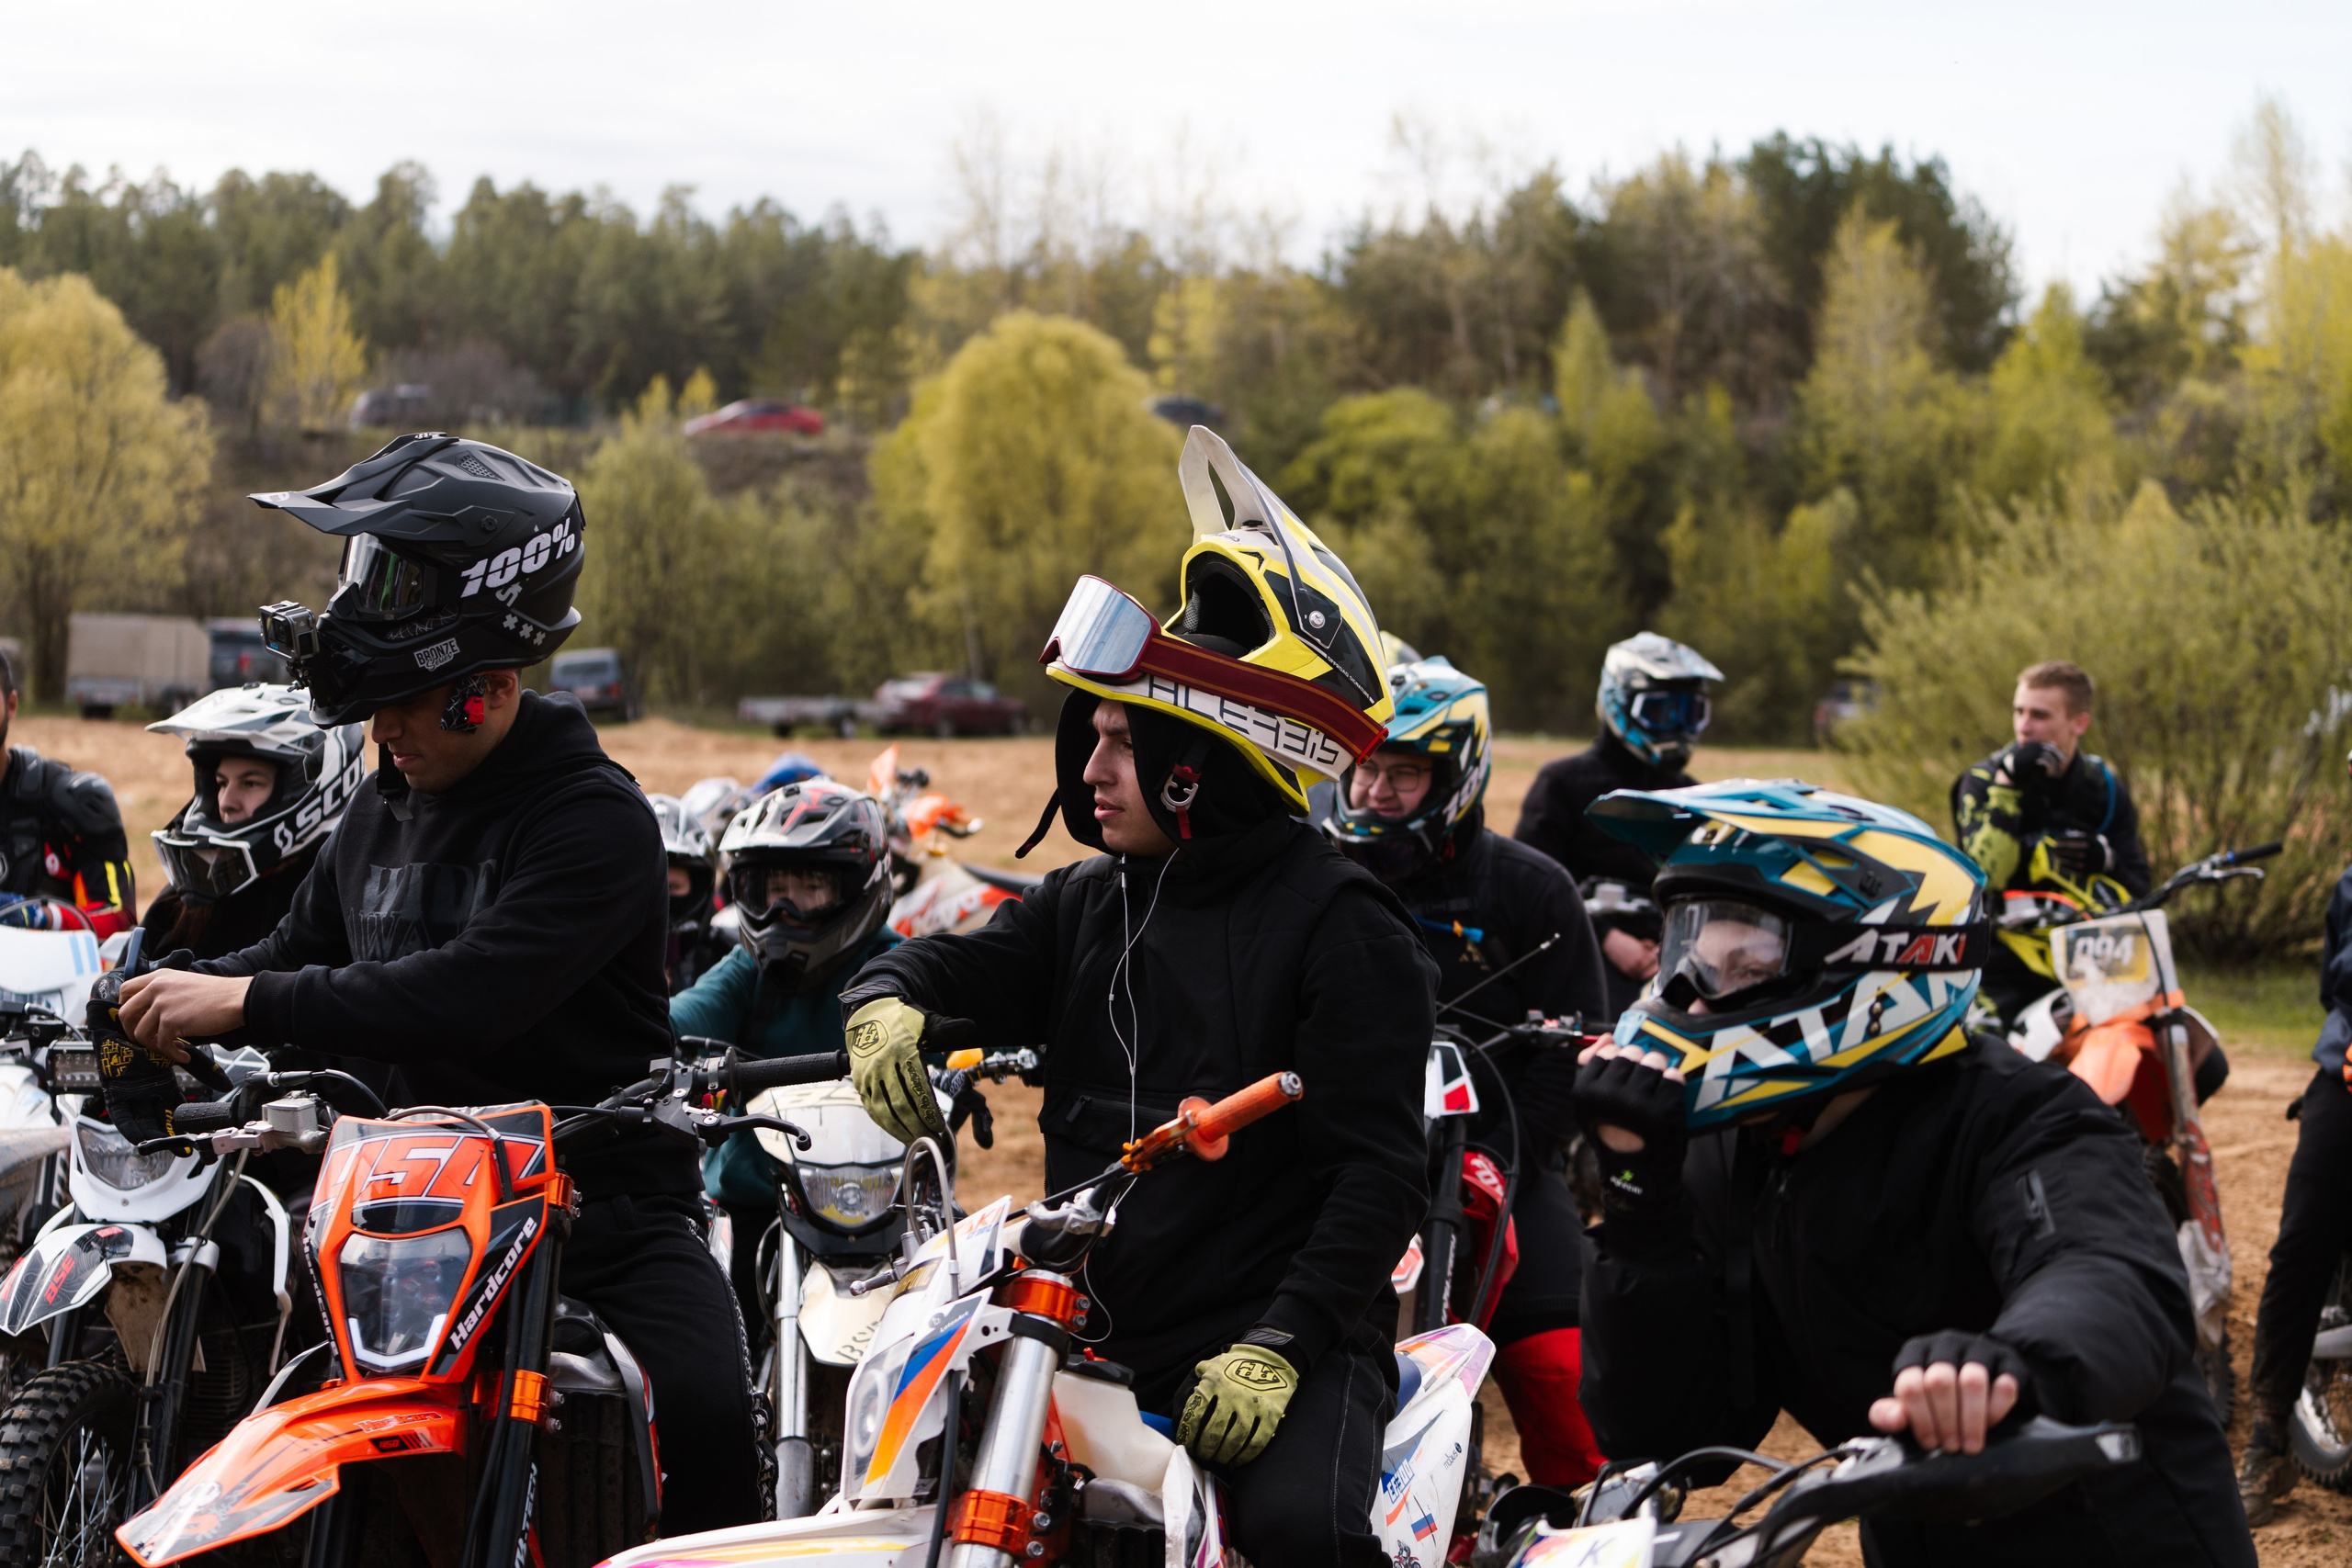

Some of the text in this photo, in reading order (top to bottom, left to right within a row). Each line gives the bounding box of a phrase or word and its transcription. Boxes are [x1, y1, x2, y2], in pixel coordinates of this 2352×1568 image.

[460, 517, 575, 598] 100%
[416, 639, 458, 666] BRONZE
[426, 652, 453, 671] Series
[1327, 655, 1369, 698] OFFROAD SIGNATURE
[44, 1254, 76, 1305] BSE
[449, 1216, 537, 1350] Hardcore
